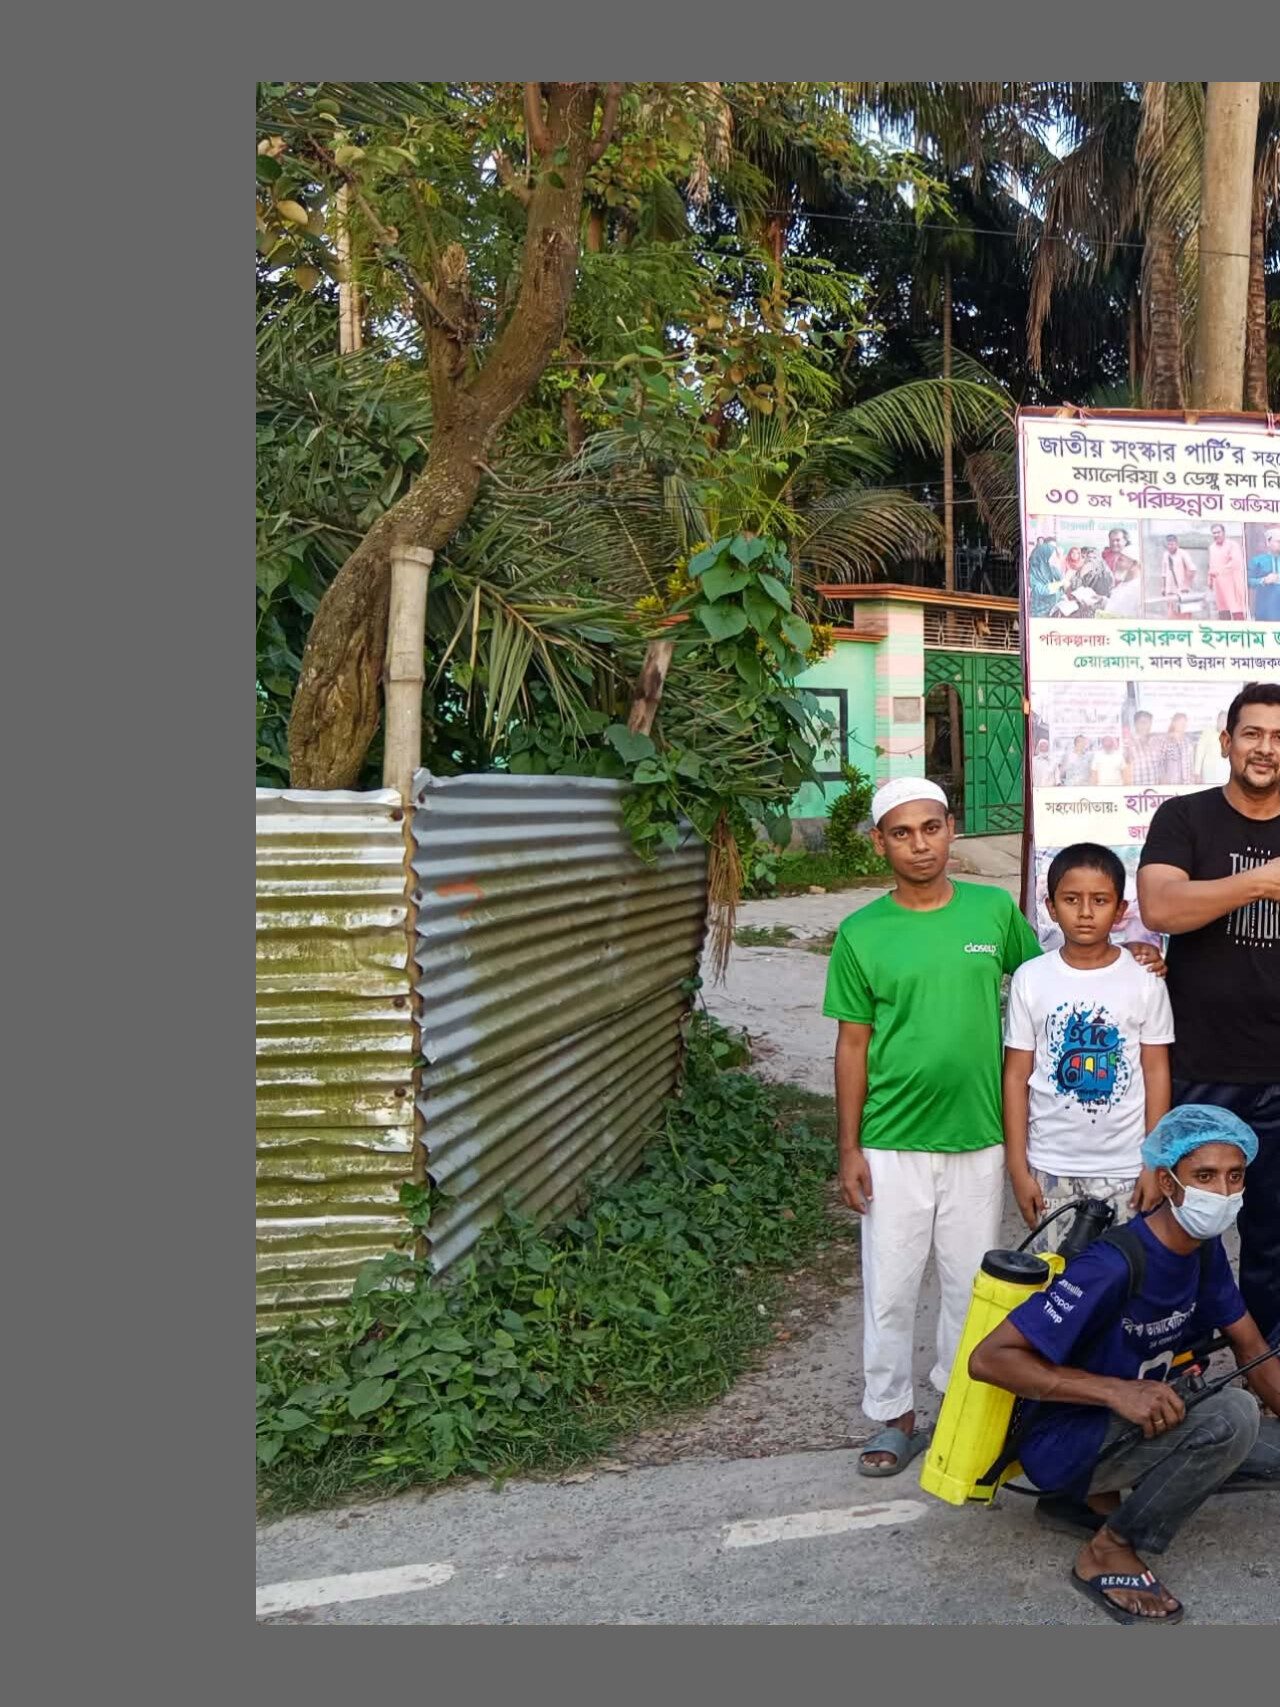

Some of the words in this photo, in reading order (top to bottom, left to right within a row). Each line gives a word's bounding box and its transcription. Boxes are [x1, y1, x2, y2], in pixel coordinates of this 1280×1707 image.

[1038, 430, 1105, 458] জাতীয়
[1110, 439, 1176, 462] সংস্কার
[1072, 464, 1158, 485] ম্যালেরিয়া
[1163, 471, 1176, 485] ও
[1183, 471, 1220, 491] ডেঙ্গু
[1224, 472, 1258, 488] মশা
[1045, 489, 1079, 504] ৩০
[1087, 493, 1112, 508] তম
[1117, 627, 1193, 647] কামরুল
[1199, 624, 1267, 649] ইসলাম
[1073, 655, 1145, 671] চেয়ারম্যান,
[1149, 655, 1183, 669] মানব
[1187, 653, 1225, 671] উন্নয়ন
